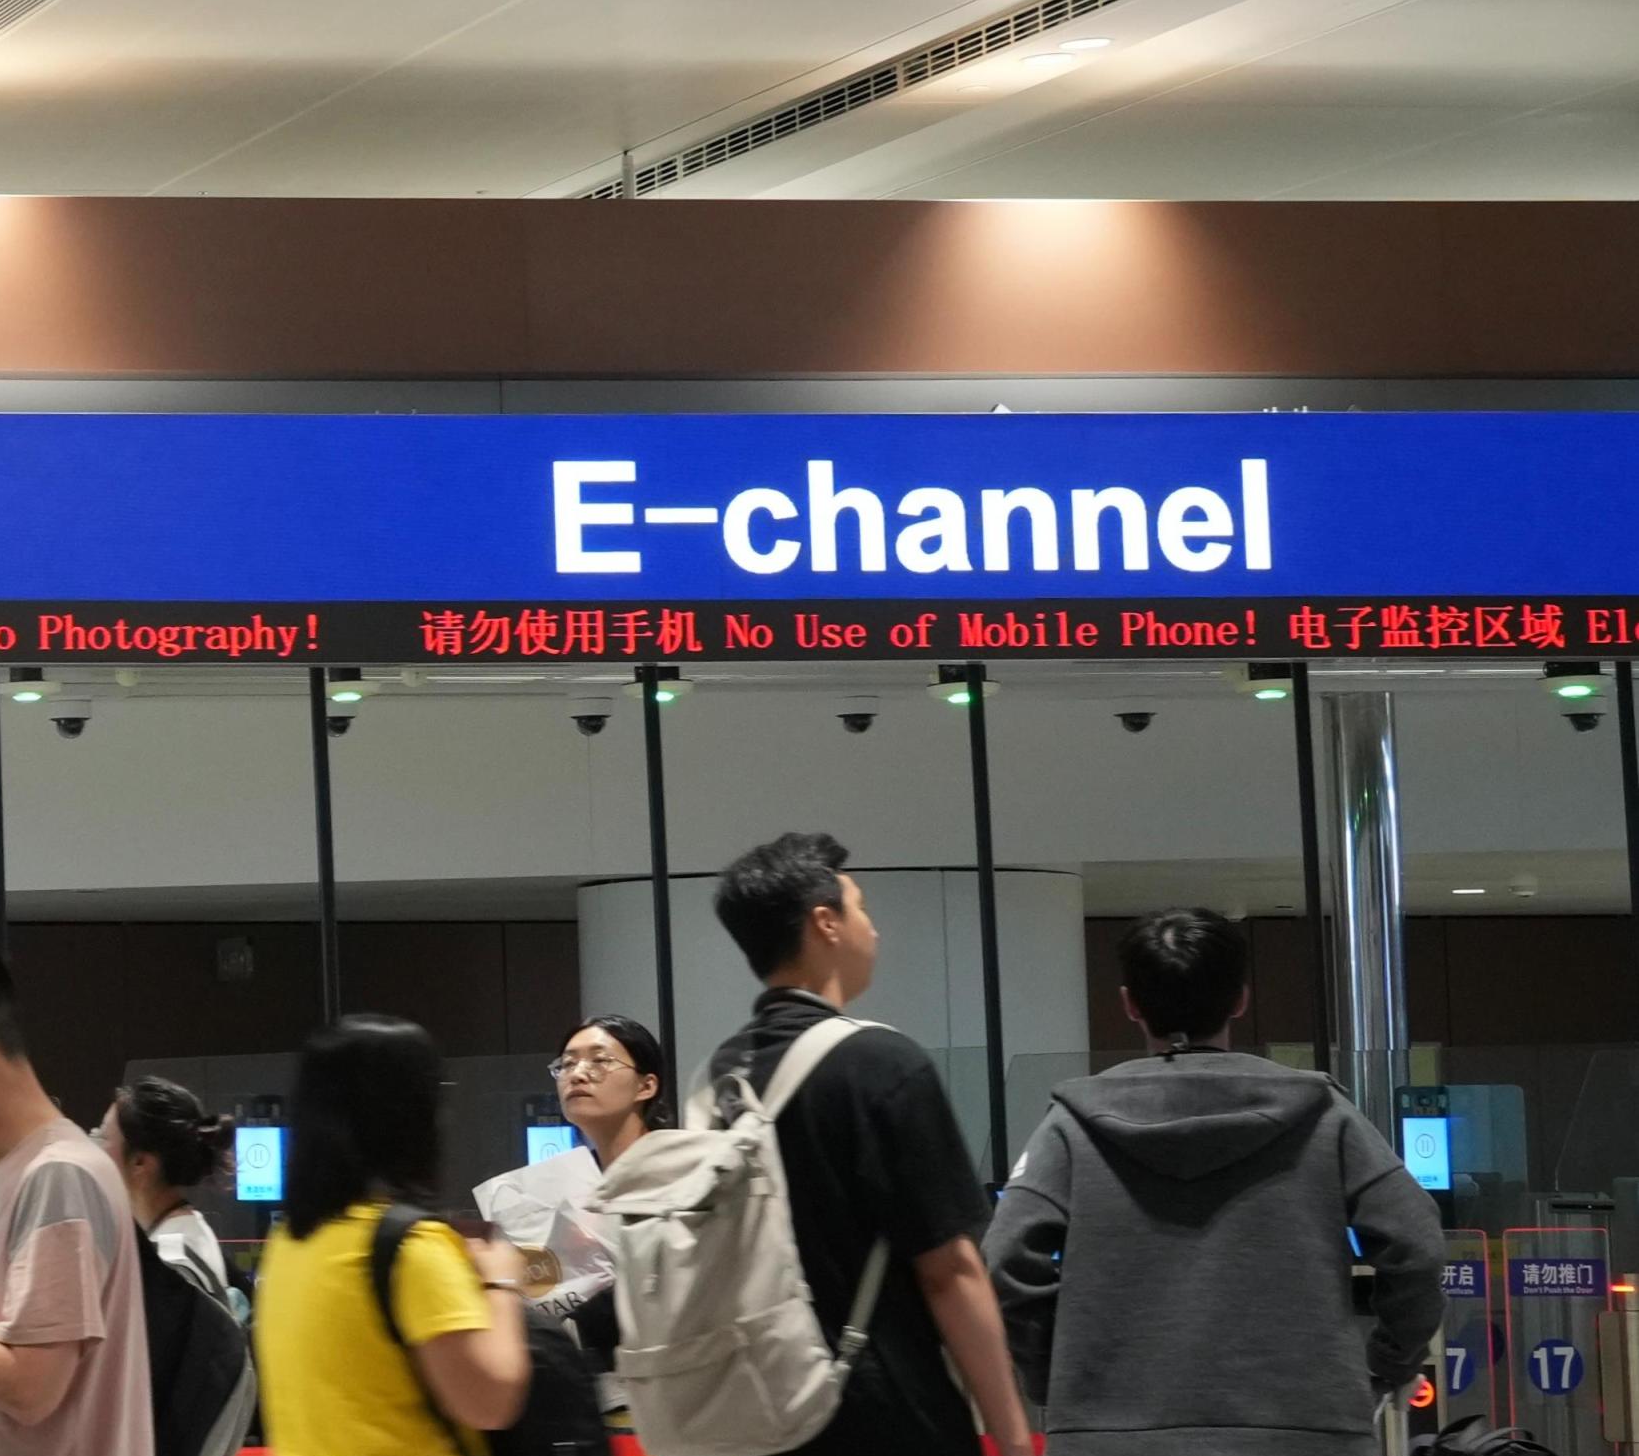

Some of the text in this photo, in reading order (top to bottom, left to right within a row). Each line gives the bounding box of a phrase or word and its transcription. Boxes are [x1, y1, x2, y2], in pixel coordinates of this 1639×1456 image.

[552, 459, 1272, 574] E-channel
[38, 613, 319, 657] Photography!
[420, 608, 703, 656] 请勿使用手机
[724, 614, 774, 649] No
[795, 613, 867, 648] Use
[889, 612, 938, 648] of
[958, 610, 1098, 648] Mobile
[1120, 609, 1258, 647] Phone!
[1289, 605, 1565, 650] 电子监控区域
[1441, 1264, 1475, 1286] 开启
[1522, 1263, 1595, 1286] 请勿推门
[1445, 1346, 1468, 1390] 7
[1532, 1346, 1576, 1390] 17
